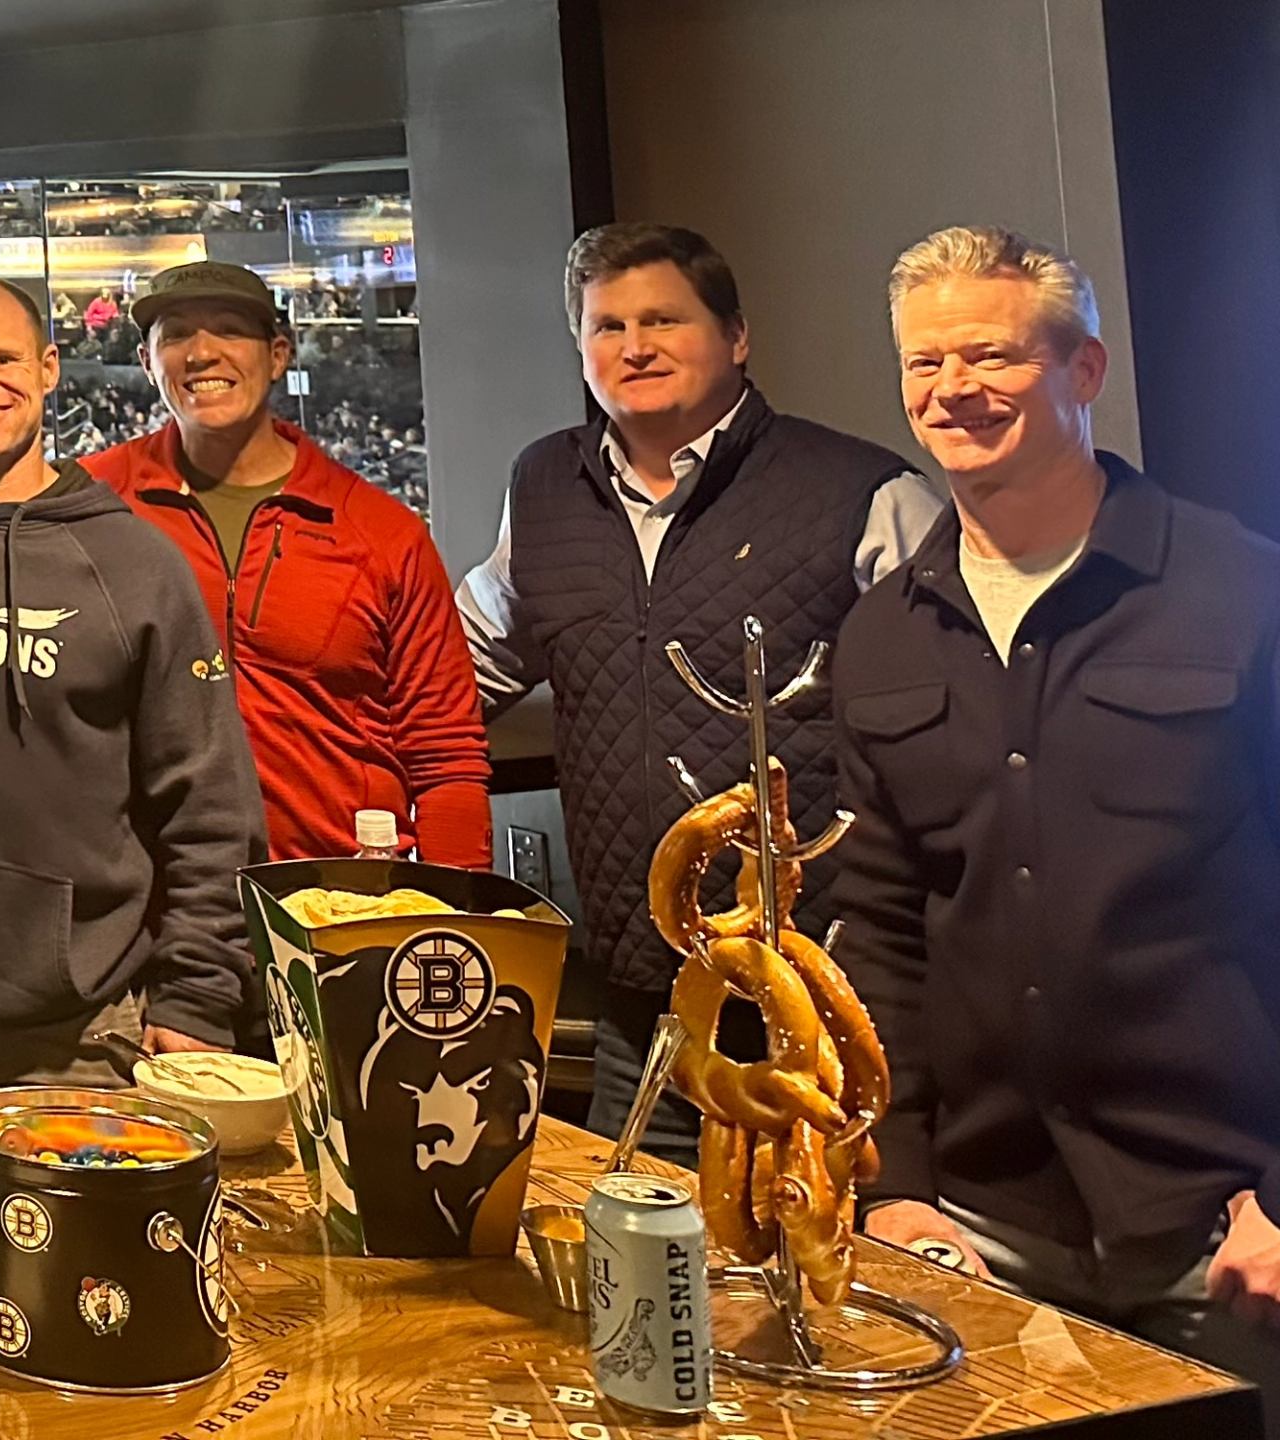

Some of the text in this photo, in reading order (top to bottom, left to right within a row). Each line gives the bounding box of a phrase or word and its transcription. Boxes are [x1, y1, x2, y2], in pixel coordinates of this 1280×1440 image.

[415, 953, 466, 1014] B
[15, 1206, 37, 1239] B
[666, 1241, 697, 1402] COLD SNAP
[195, 1367, 289, 1433] HARBOR
